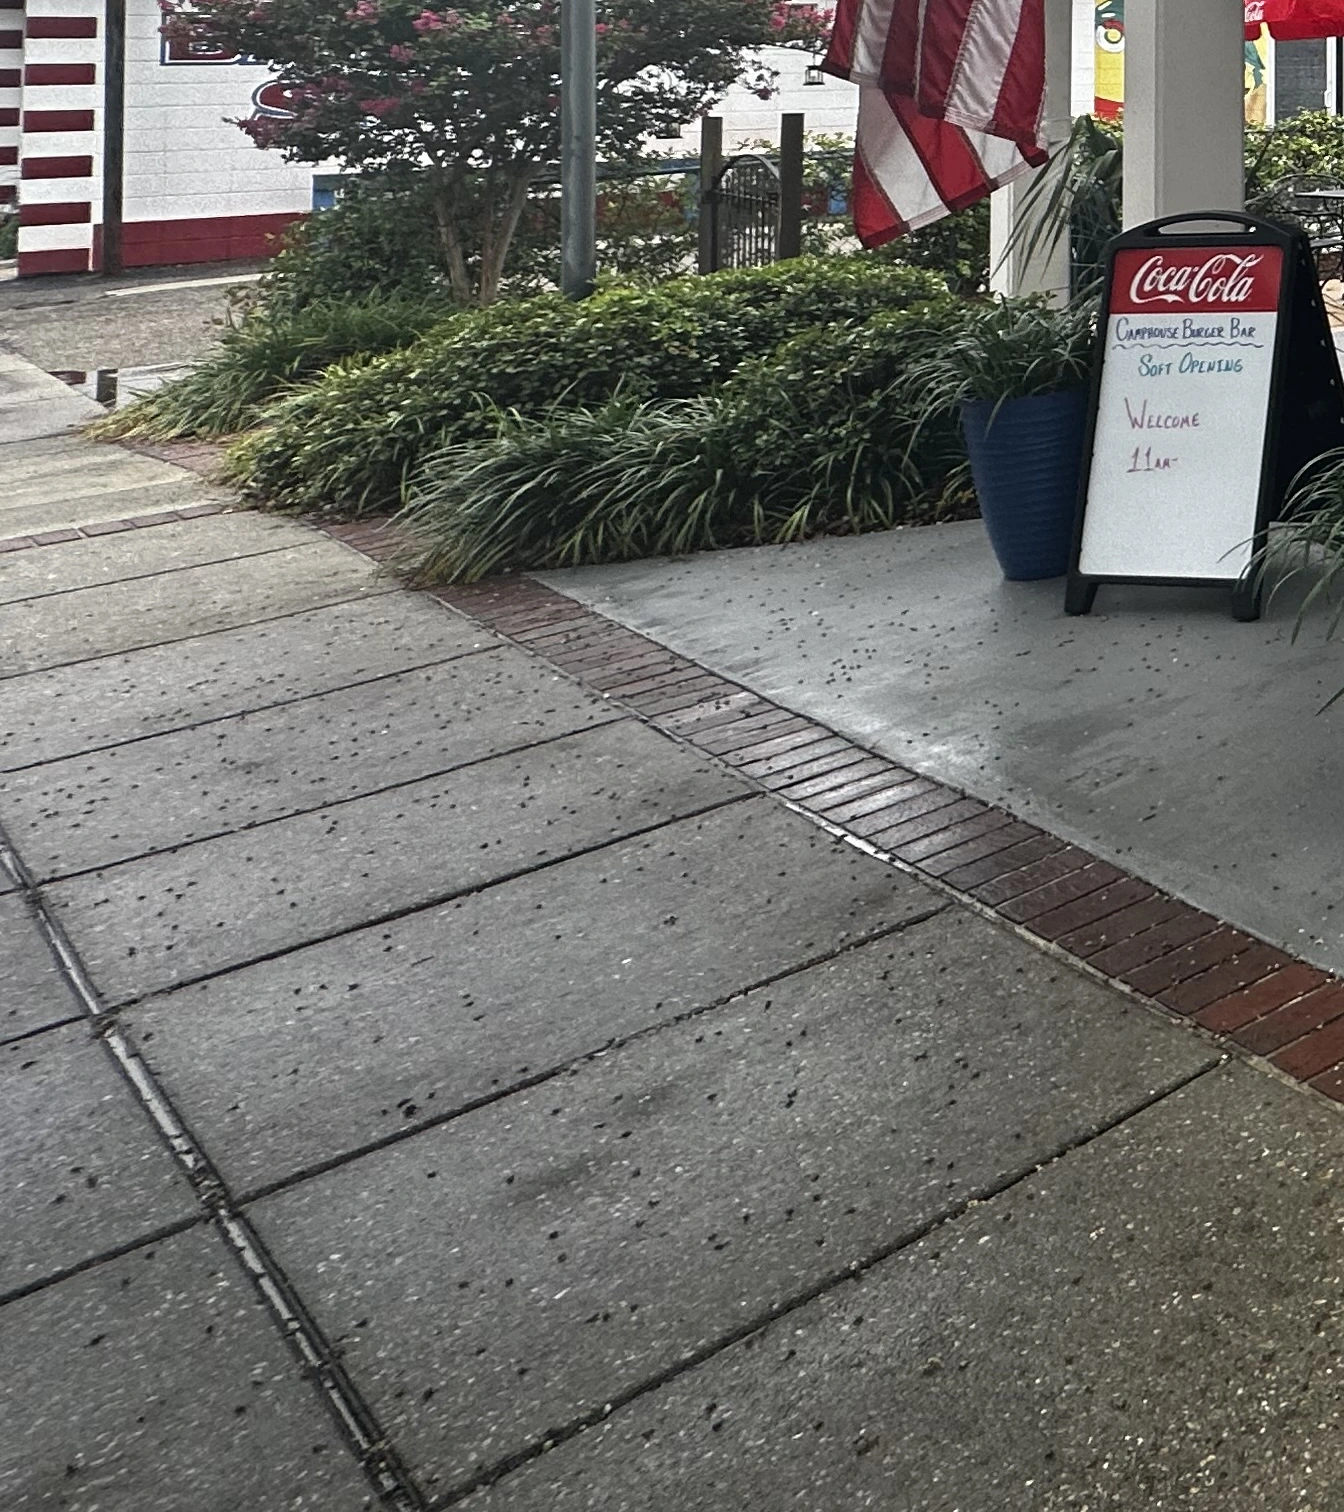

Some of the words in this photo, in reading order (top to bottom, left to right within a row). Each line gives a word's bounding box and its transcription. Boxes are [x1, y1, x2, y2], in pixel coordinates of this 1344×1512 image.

[1131, 253, 1264, 305] Coca-Cola
[1182, 317, 1225, 339] BURGER
[1230, 317, 1256, 339] BAR
[1138, 353, 1173, 377] SOFT
[1178, 351, 1244, 374] OPENING
[1124, 396, 1200, 429] WELCOME
